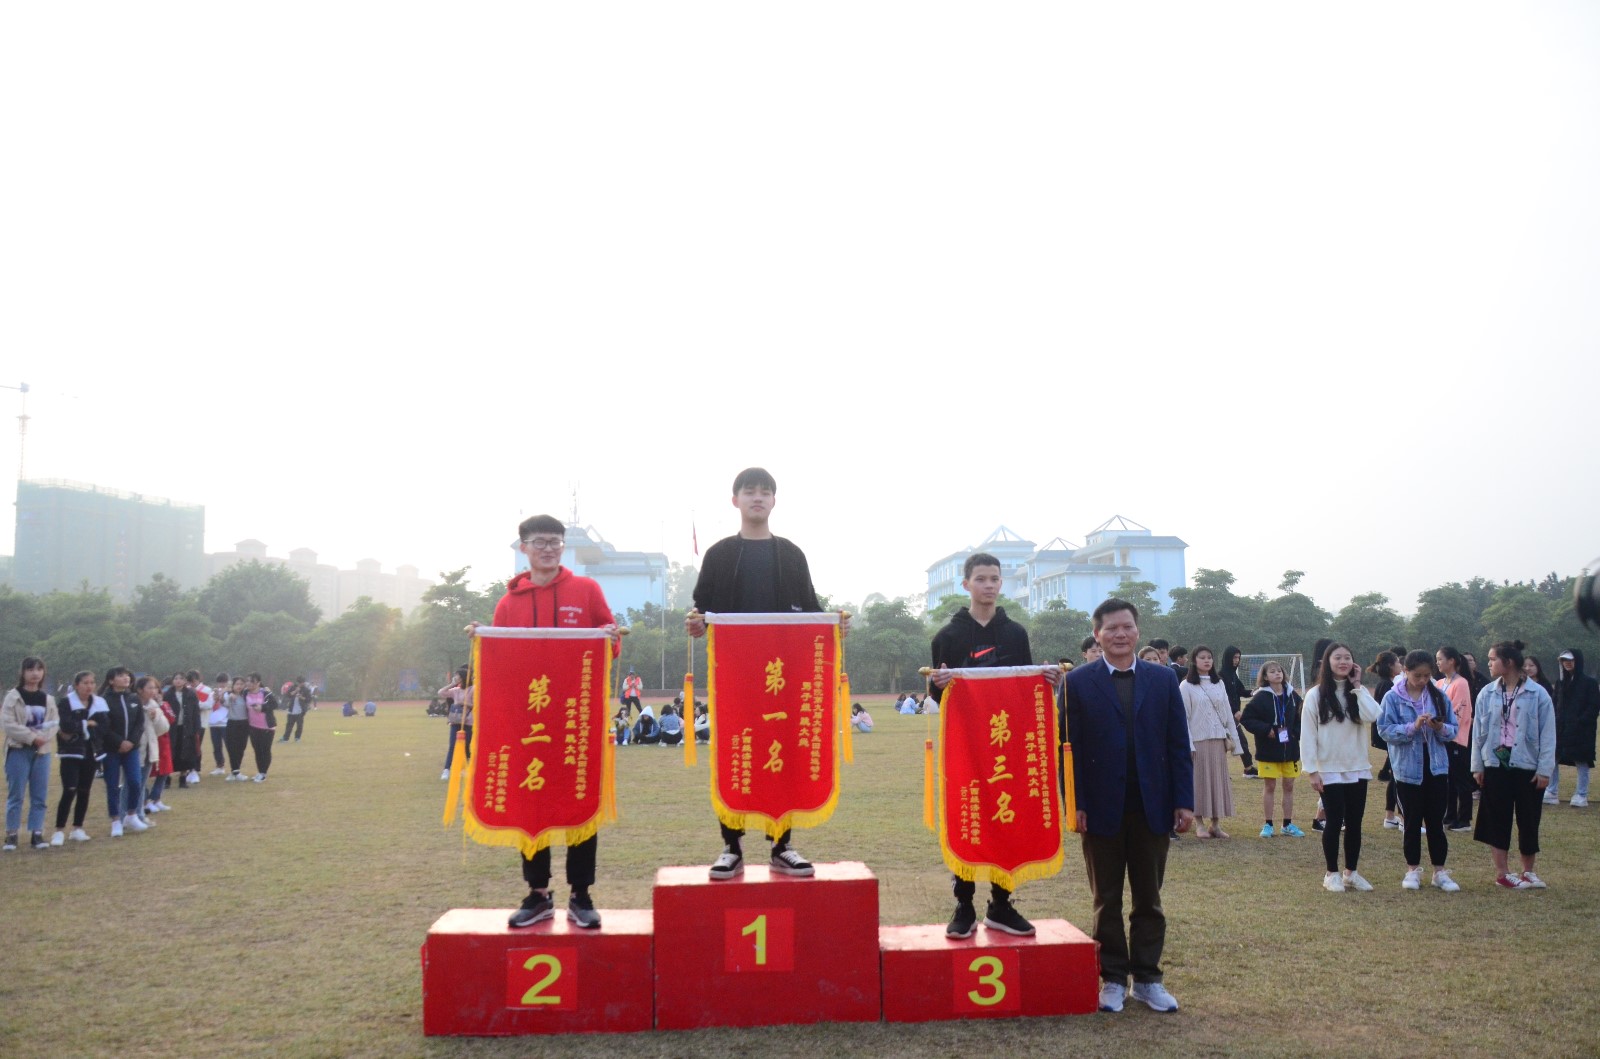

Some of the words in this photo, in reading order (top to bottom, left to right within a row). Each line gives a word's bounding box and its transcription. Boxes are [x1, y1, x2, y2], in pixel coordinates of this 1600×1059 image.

[566, 698, 577, 728] 男子组
[763, 658, 787, 772] 第一名
[801, 682, 812, 711] 男子组
[520, 675, 551, 790] 第二名
[1025, 732, 1037, 762] 男子组
[987, 710, 1015, 823] 第三名
[742, 915, 766, 964] 1
[522, 954, 561, 1004] 2
[968, 956, 1005, 1005] 3
